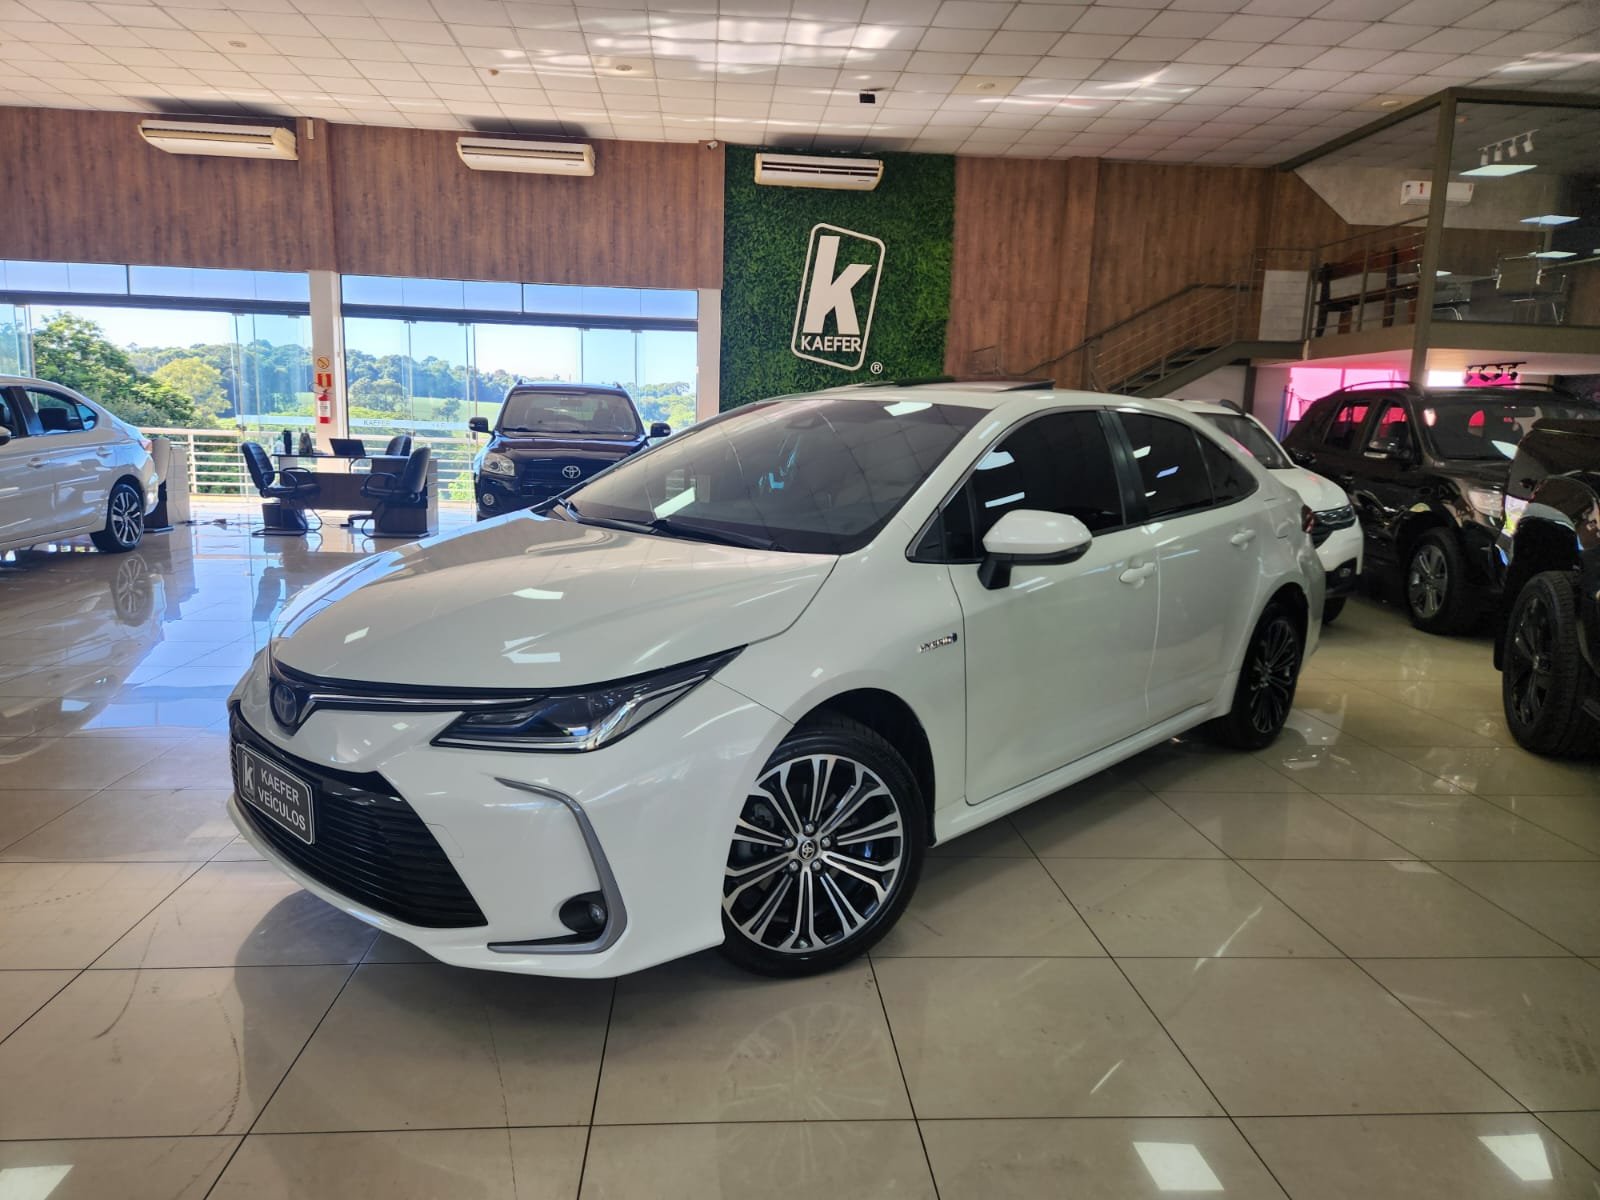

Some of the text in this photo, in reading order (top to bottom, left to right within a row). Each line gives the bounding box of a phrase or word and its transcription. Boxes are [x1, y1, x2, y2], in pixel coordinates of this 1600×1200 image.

[800, 335, 861, 352] KAEFER
[260, 767, 300, 806] KAEFER
[257, 786, 306, 831] VEÍCULOS
